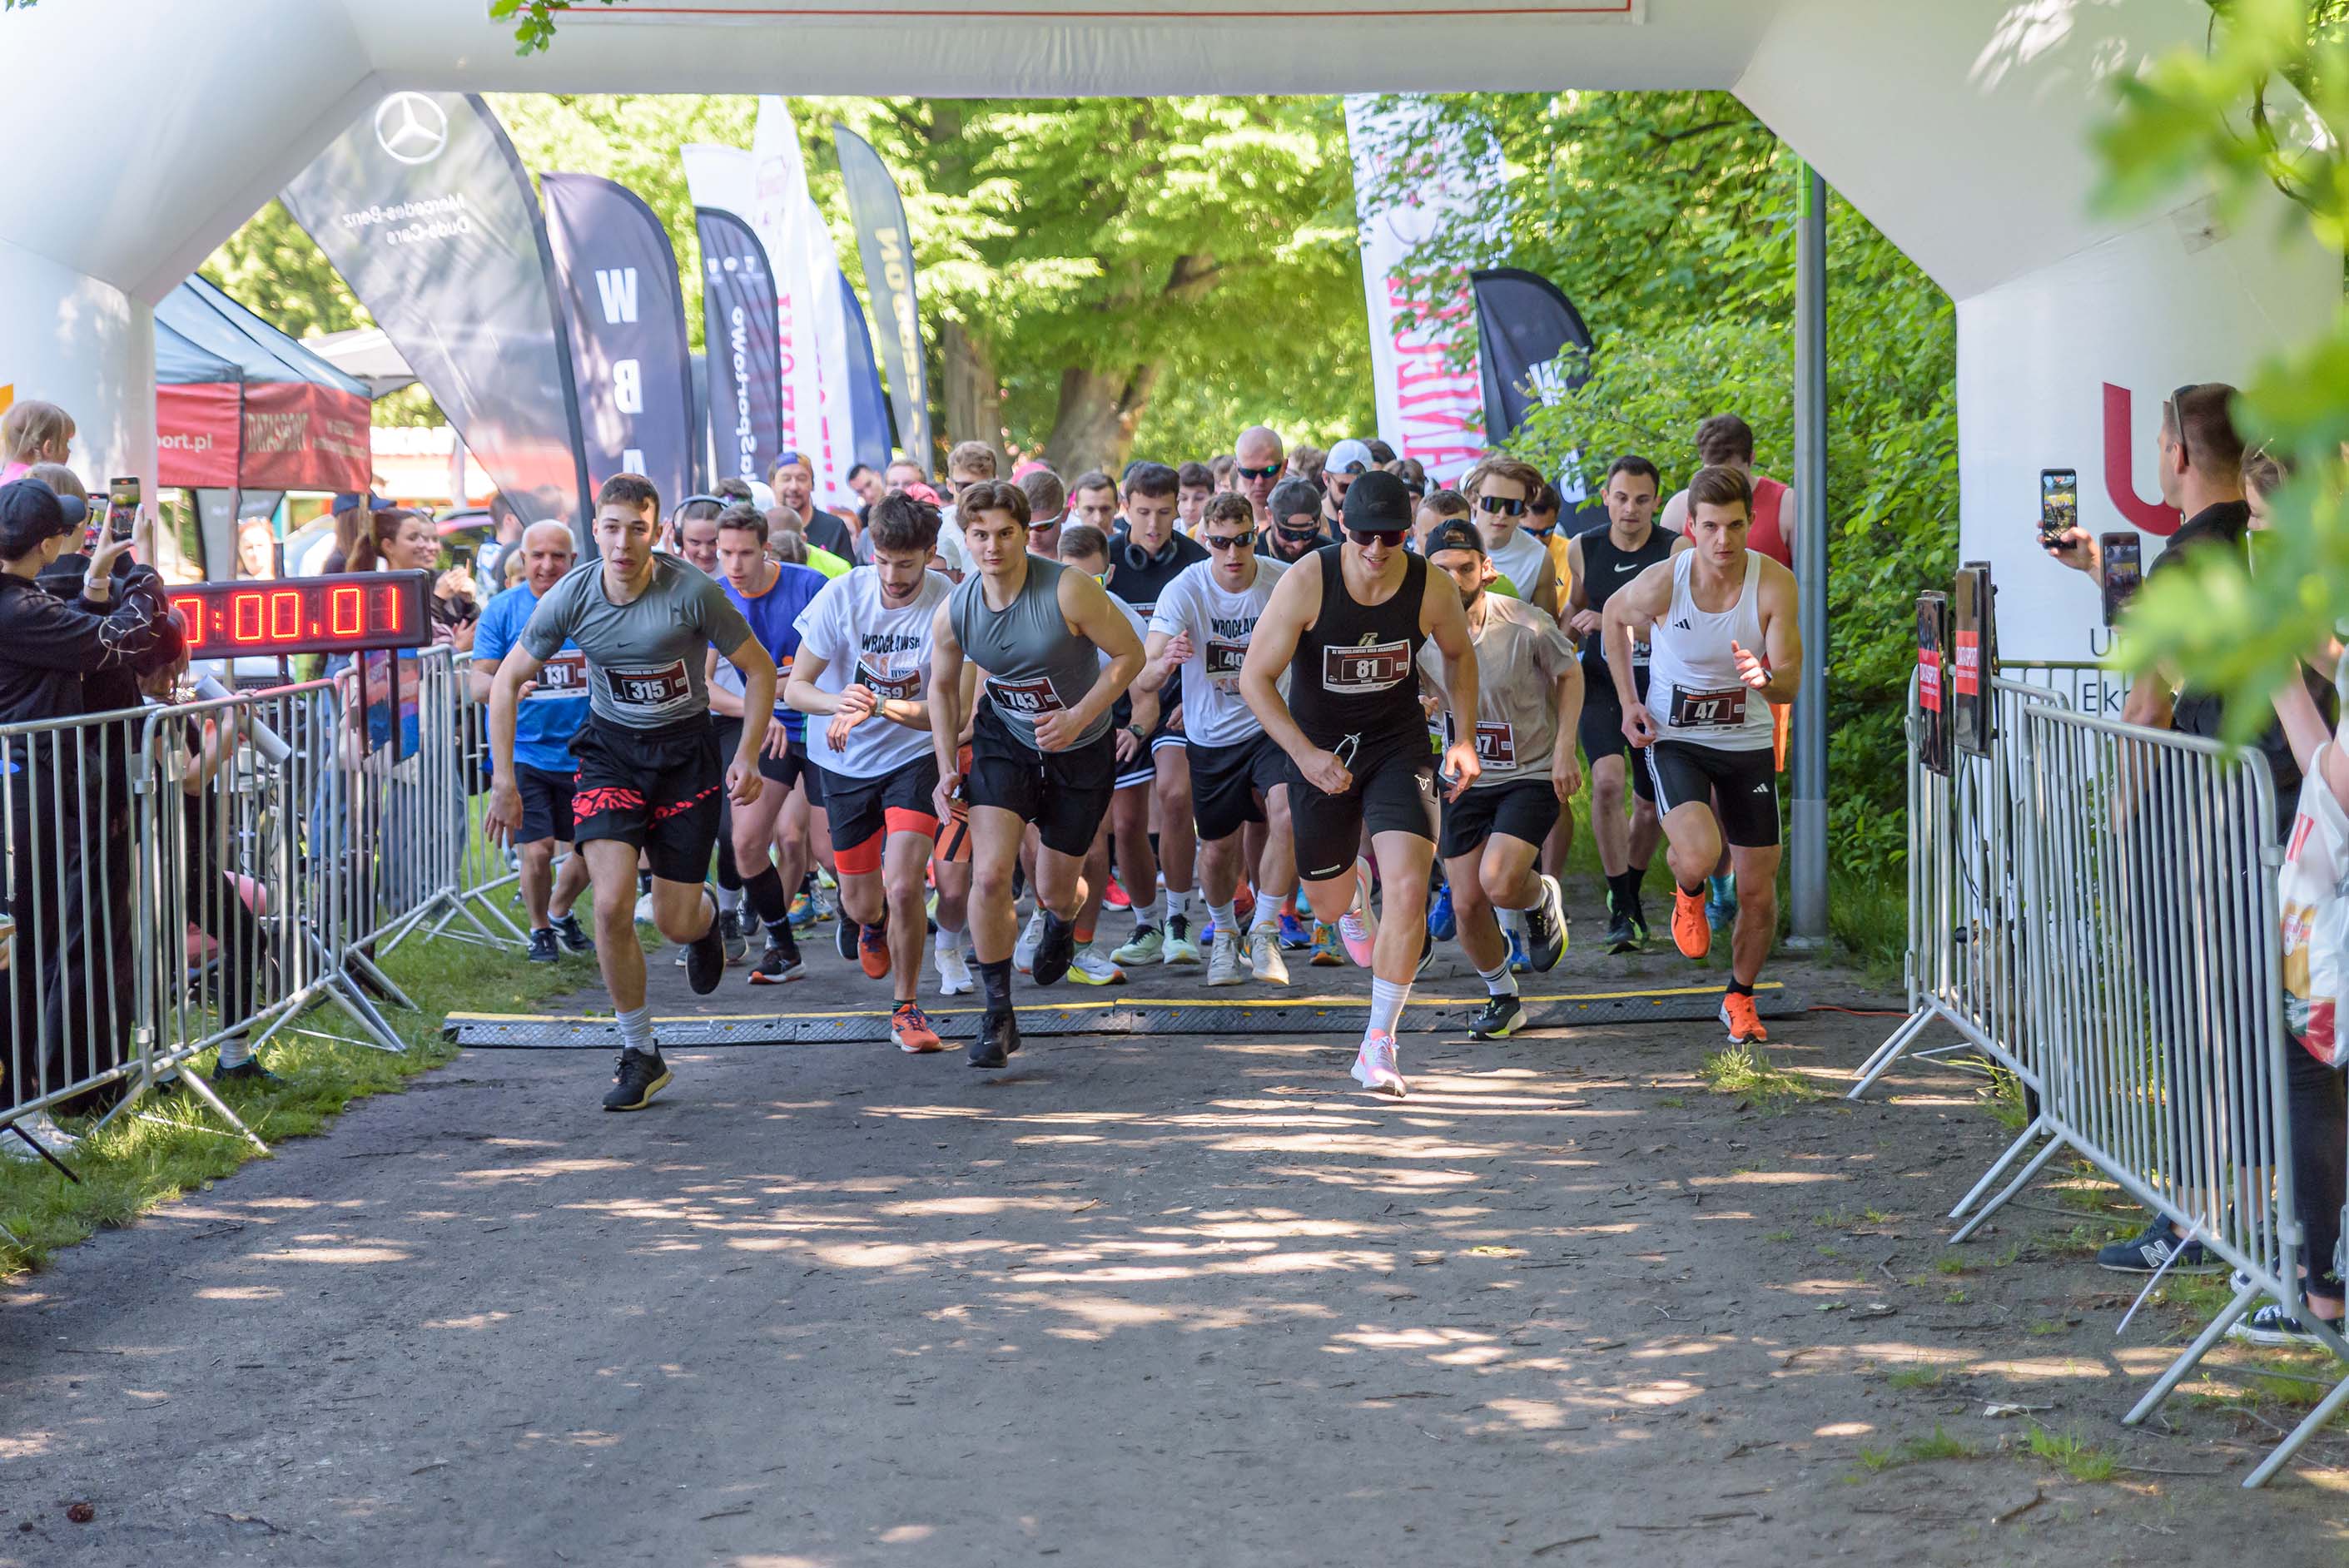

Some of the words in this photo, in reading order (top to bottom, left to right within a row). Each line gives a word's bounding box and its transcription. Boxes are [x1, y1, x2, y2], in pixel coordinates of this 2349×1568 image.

[544, 665, 569, 685] 131
[1356, 659, 1378, 678] 81
[630, 680, 665, 700] 315
[869, 682, 903, 700] 259
[1003, 691, 1039, 709] 743
[1694, 700, 1720, 719] 47
